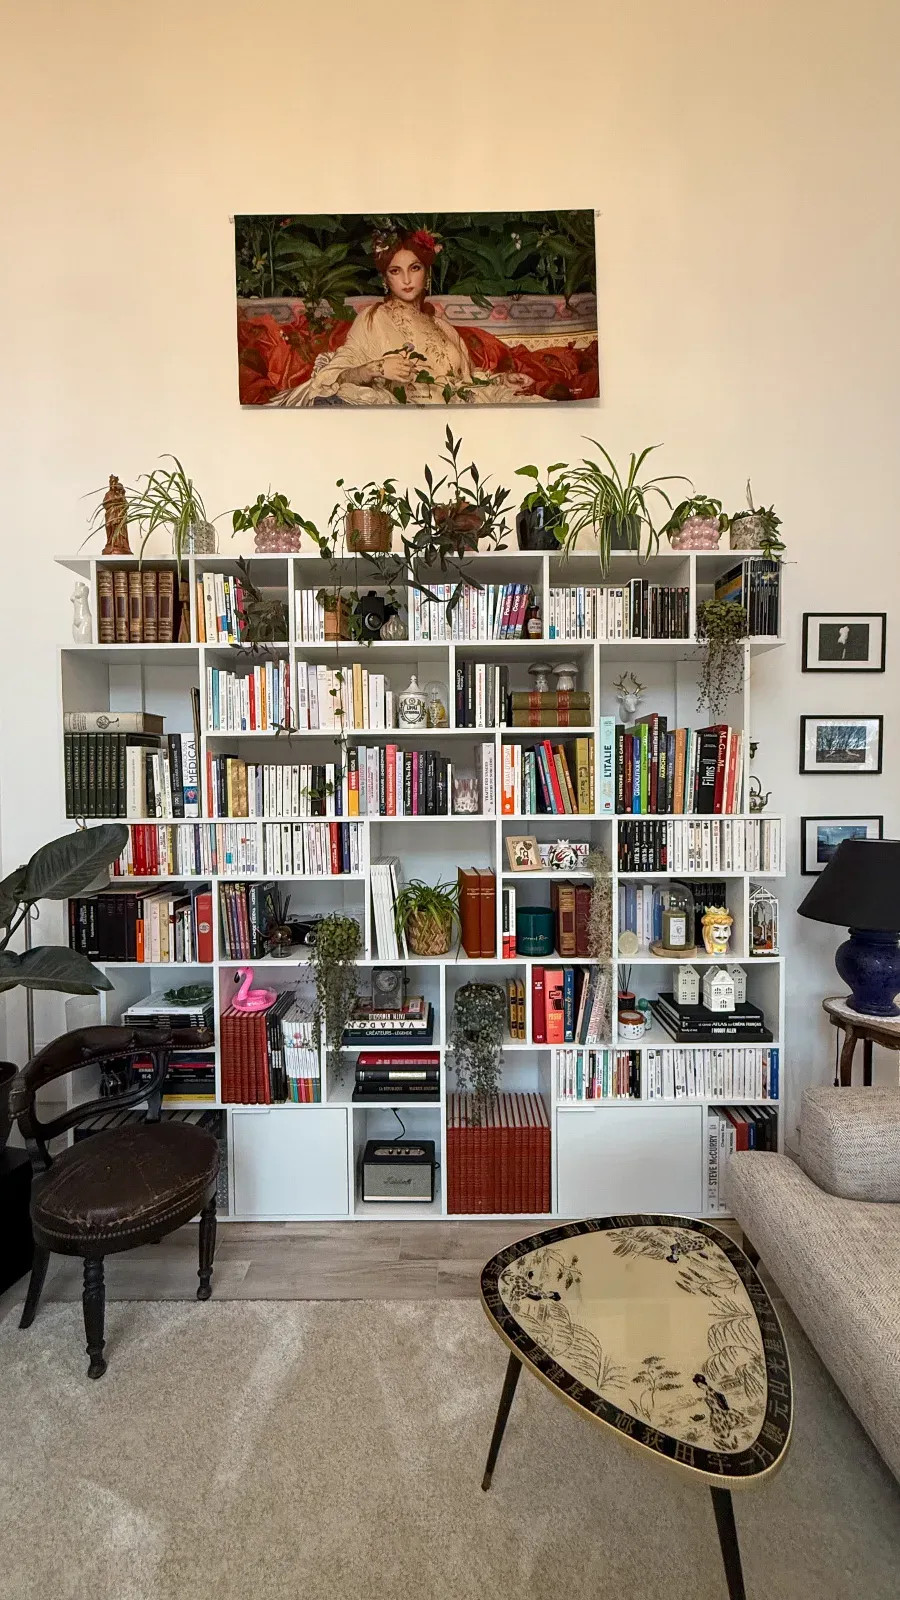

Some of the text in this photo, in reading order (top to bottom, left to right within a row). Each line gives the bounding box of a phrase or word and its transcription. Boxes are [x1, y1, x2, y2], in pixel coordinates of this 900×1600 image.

[503, 595, 512, 616] Pouilles
[512, 595, 521, 611] Corse
[604, 745, 612, 778] L'ITALIE
[702, 766, 715, 786] Films
[709, 1135, 717, 1185] STEVE McCURRY
